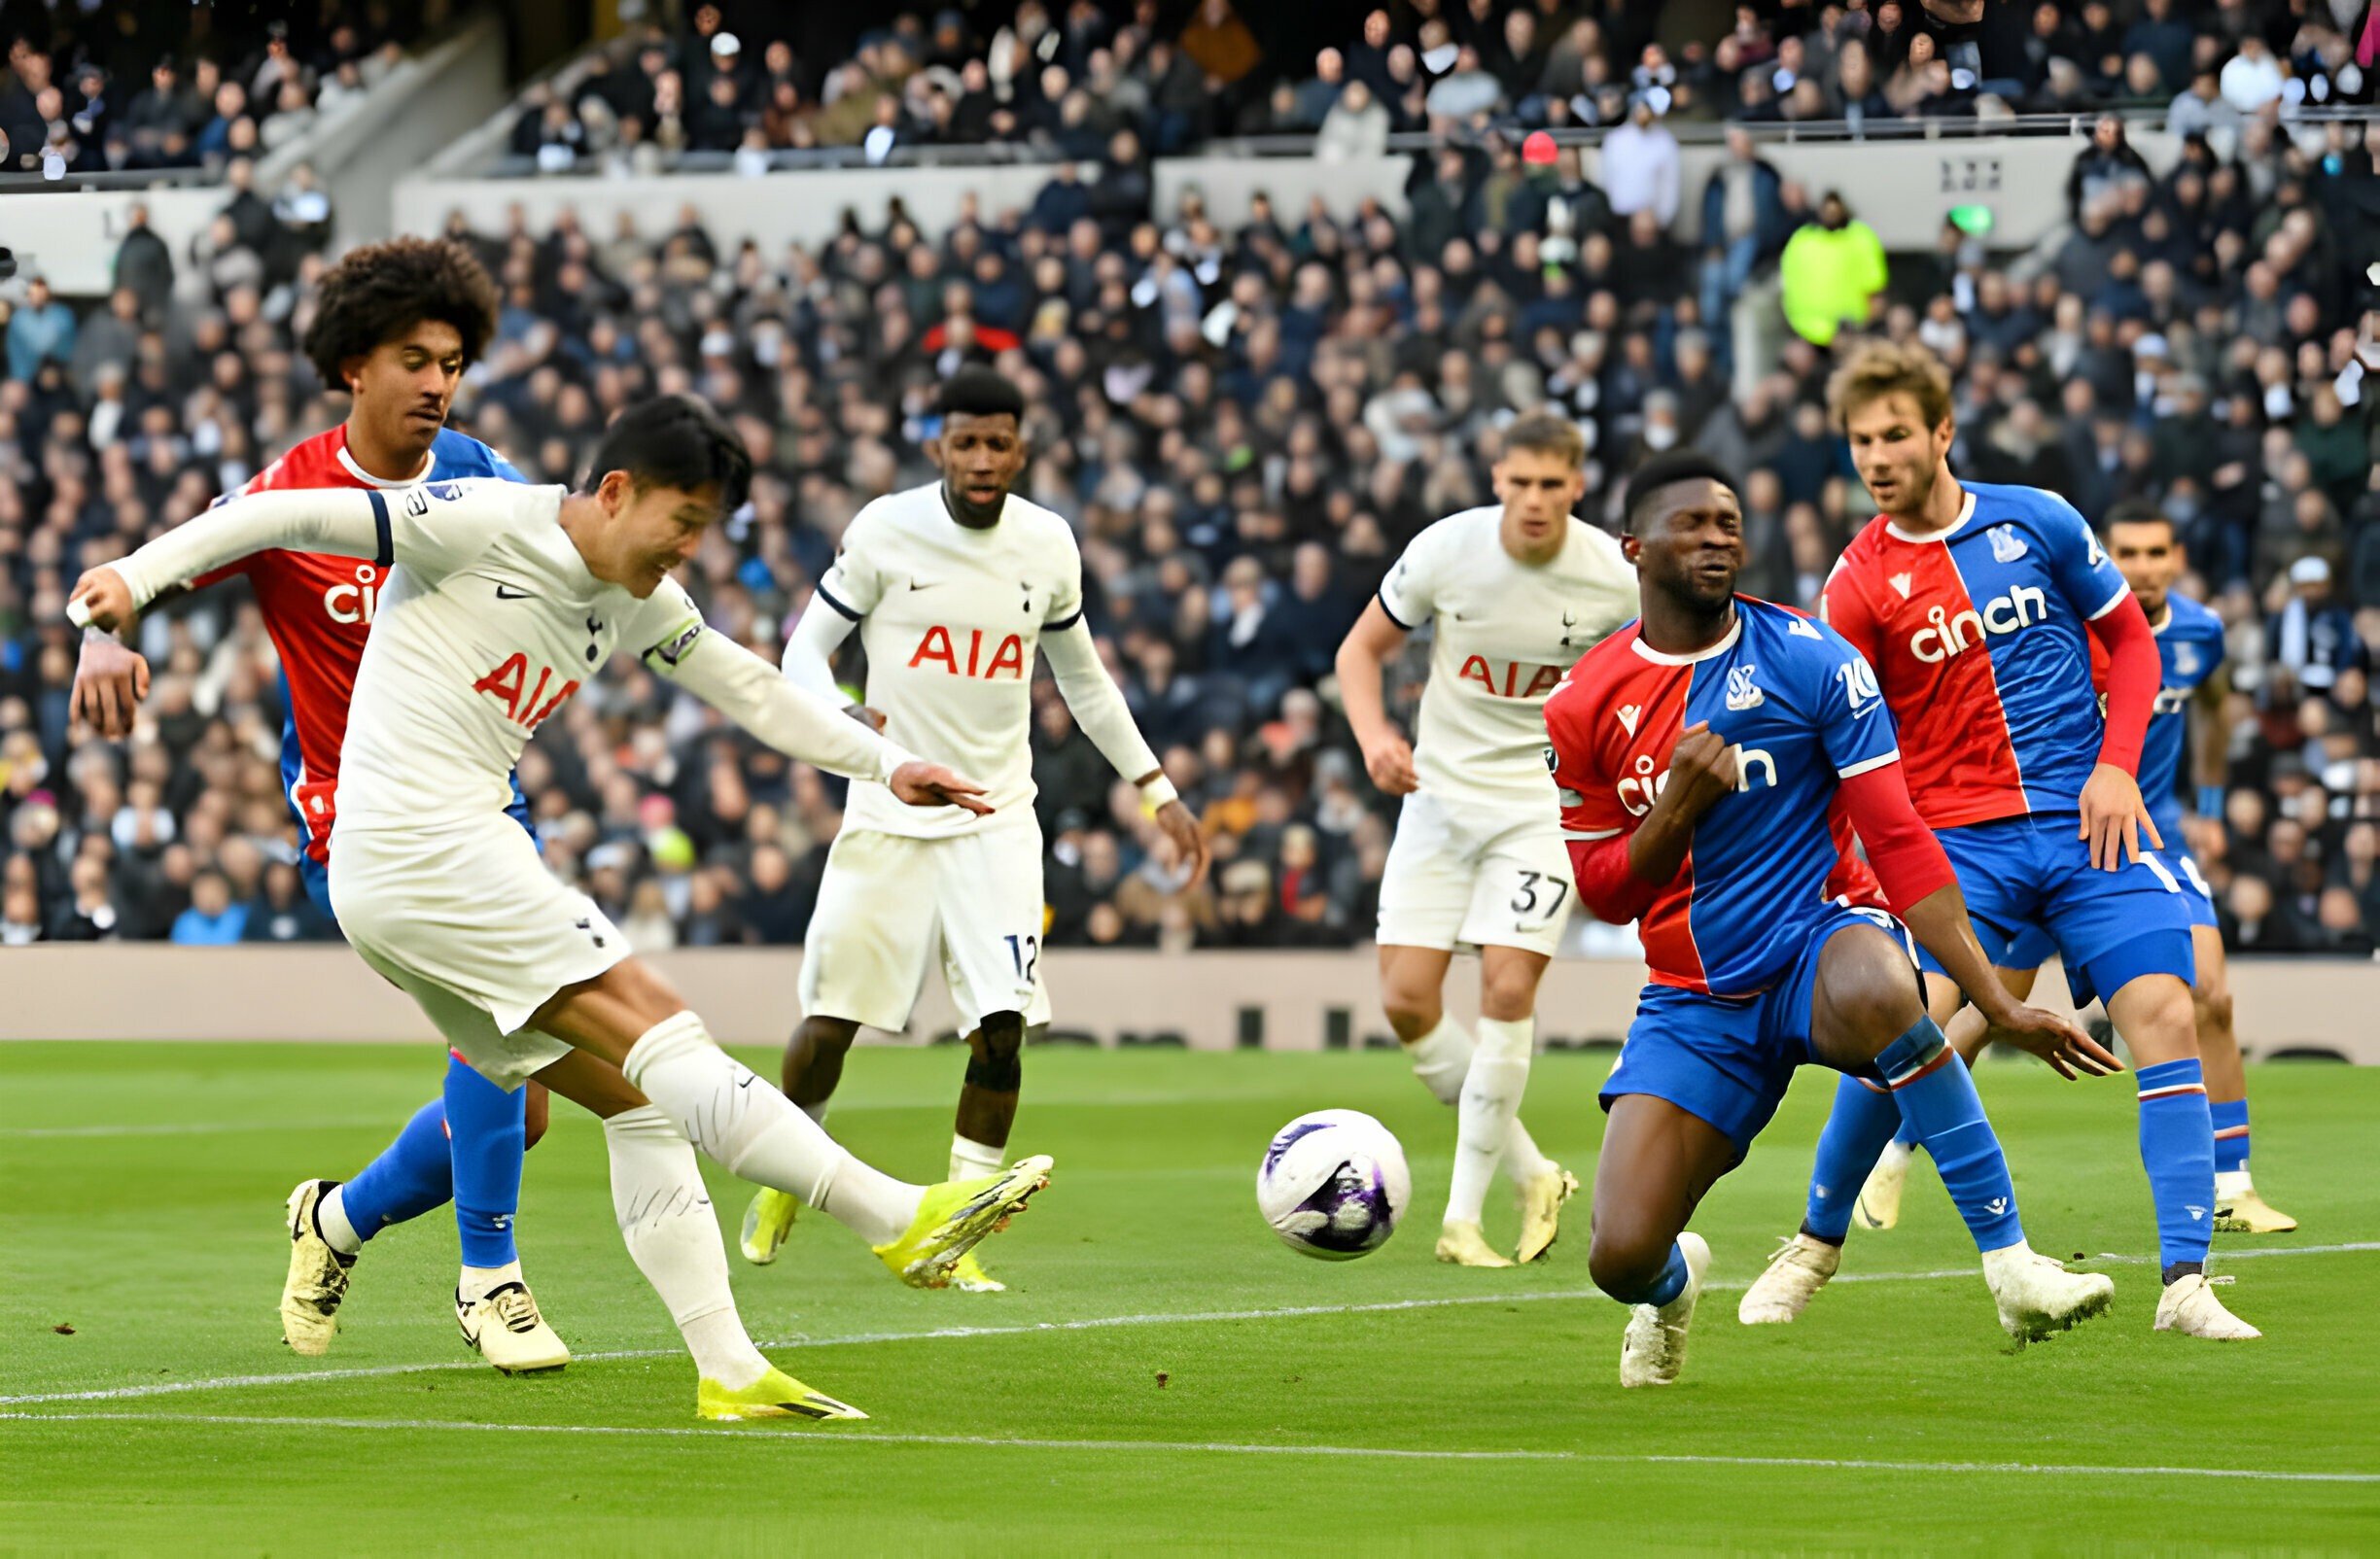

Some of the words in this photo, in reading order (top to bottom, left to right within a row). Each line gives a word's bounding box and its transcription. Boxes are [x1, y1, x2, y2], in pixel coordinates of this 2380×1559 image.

[1910, 585, 2047, 663] cinch
[908, 625, 1022, 679] AIA
[1459, 654, 1561, 698] AIA
[1617, 743, 1777, 816] cih
[1510, 870, 1568, 919] 37
[1003, 934, 1037, 986] 12
